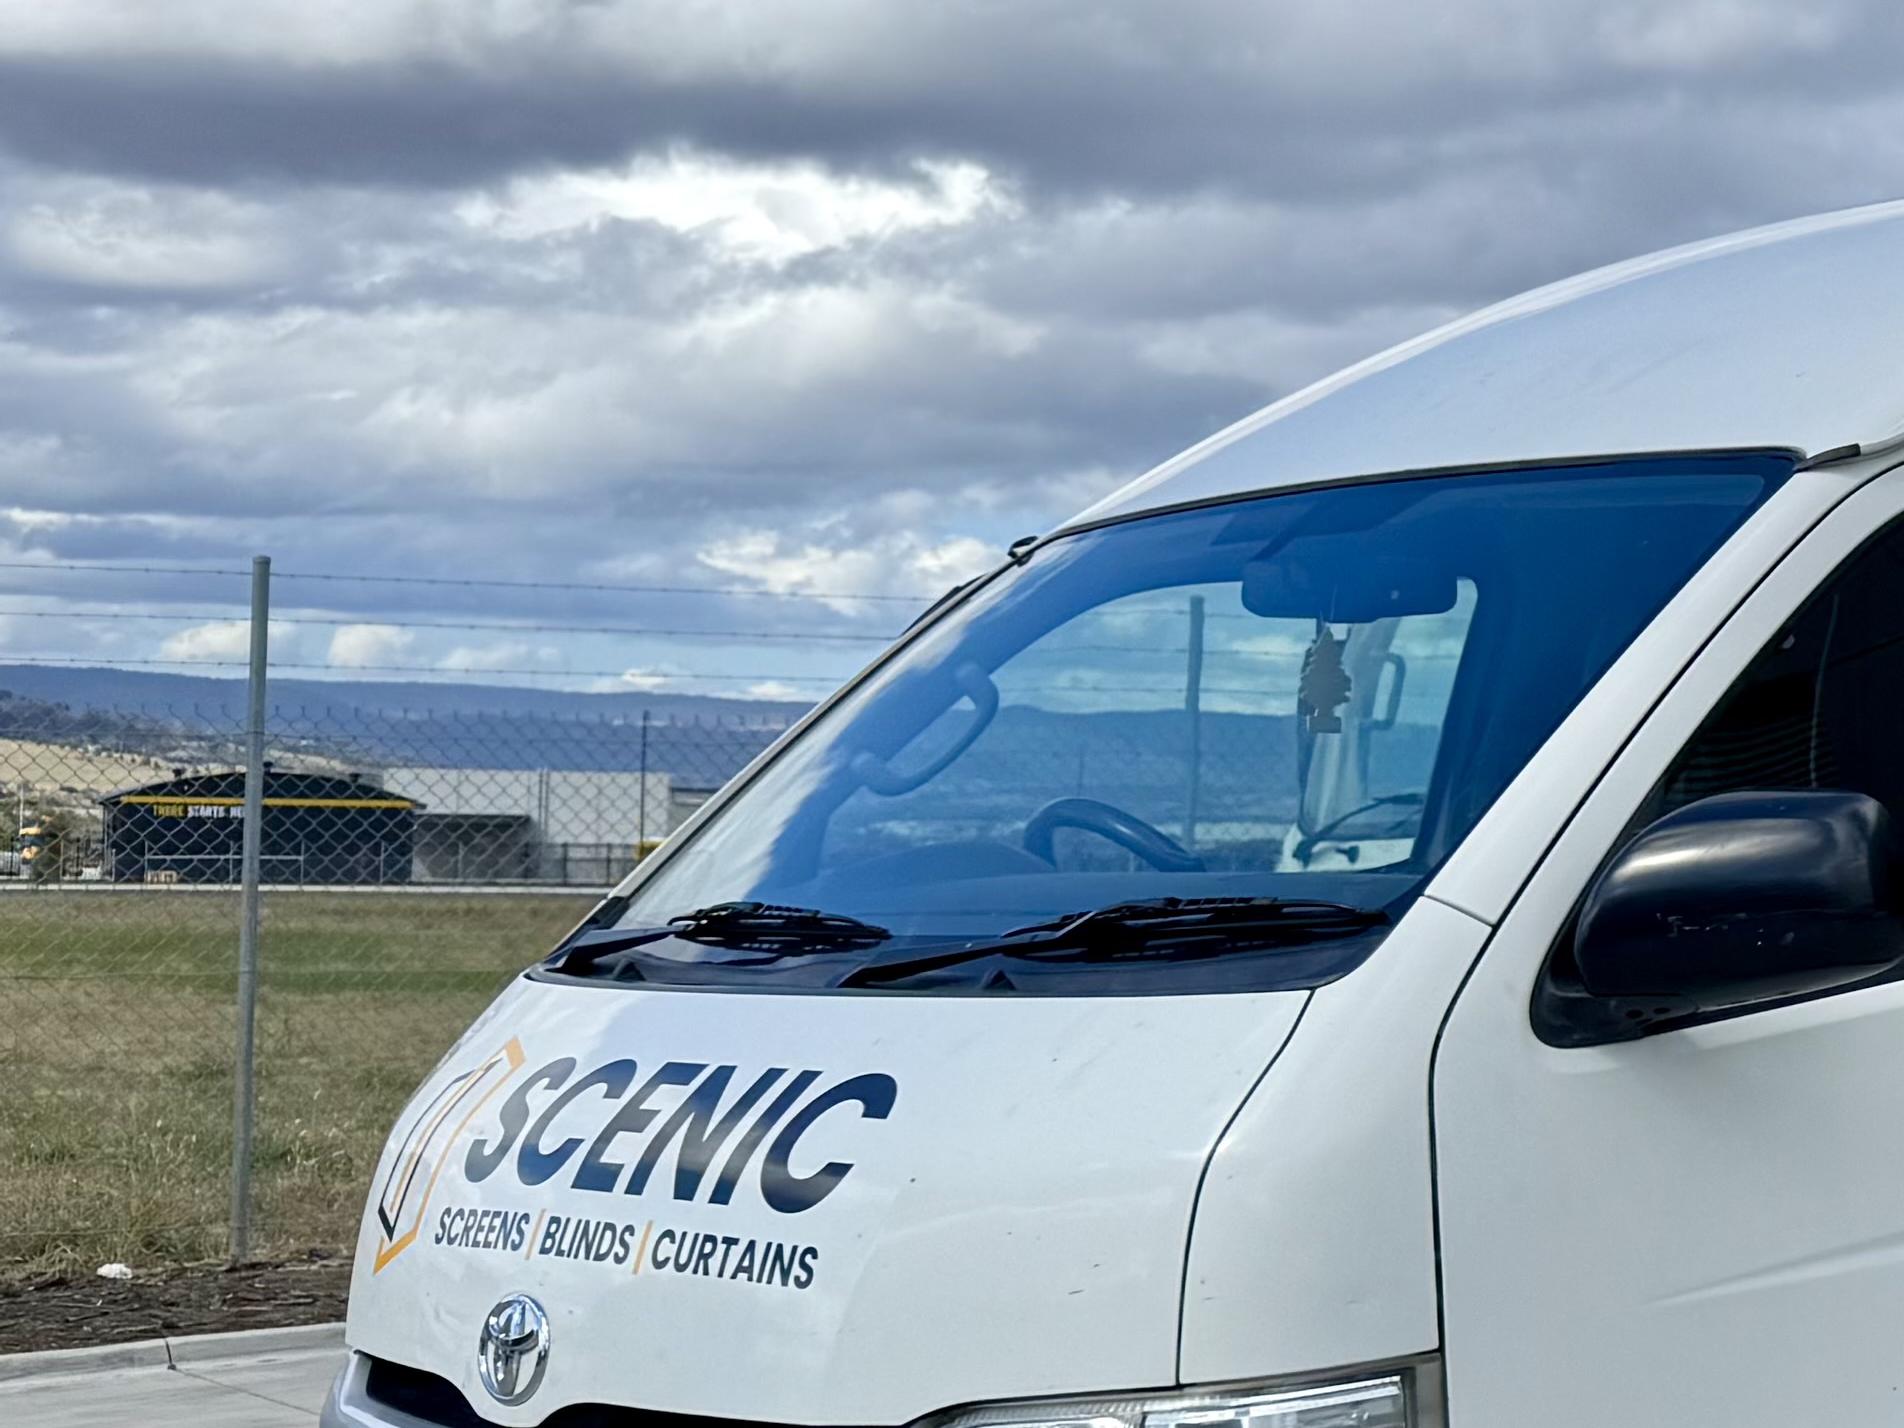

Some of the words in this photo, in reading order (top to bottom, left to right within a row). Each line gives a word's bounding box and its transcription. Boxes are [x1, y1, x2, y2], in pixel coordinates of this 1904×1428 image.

[464, 1057, 898, 1214] SCENIC
[434, 1207, 531, 1252] SCREENS
[537, 1215, 635, 1266] BLINDS
[650, 1229, 819, 1289] CURTAINS
